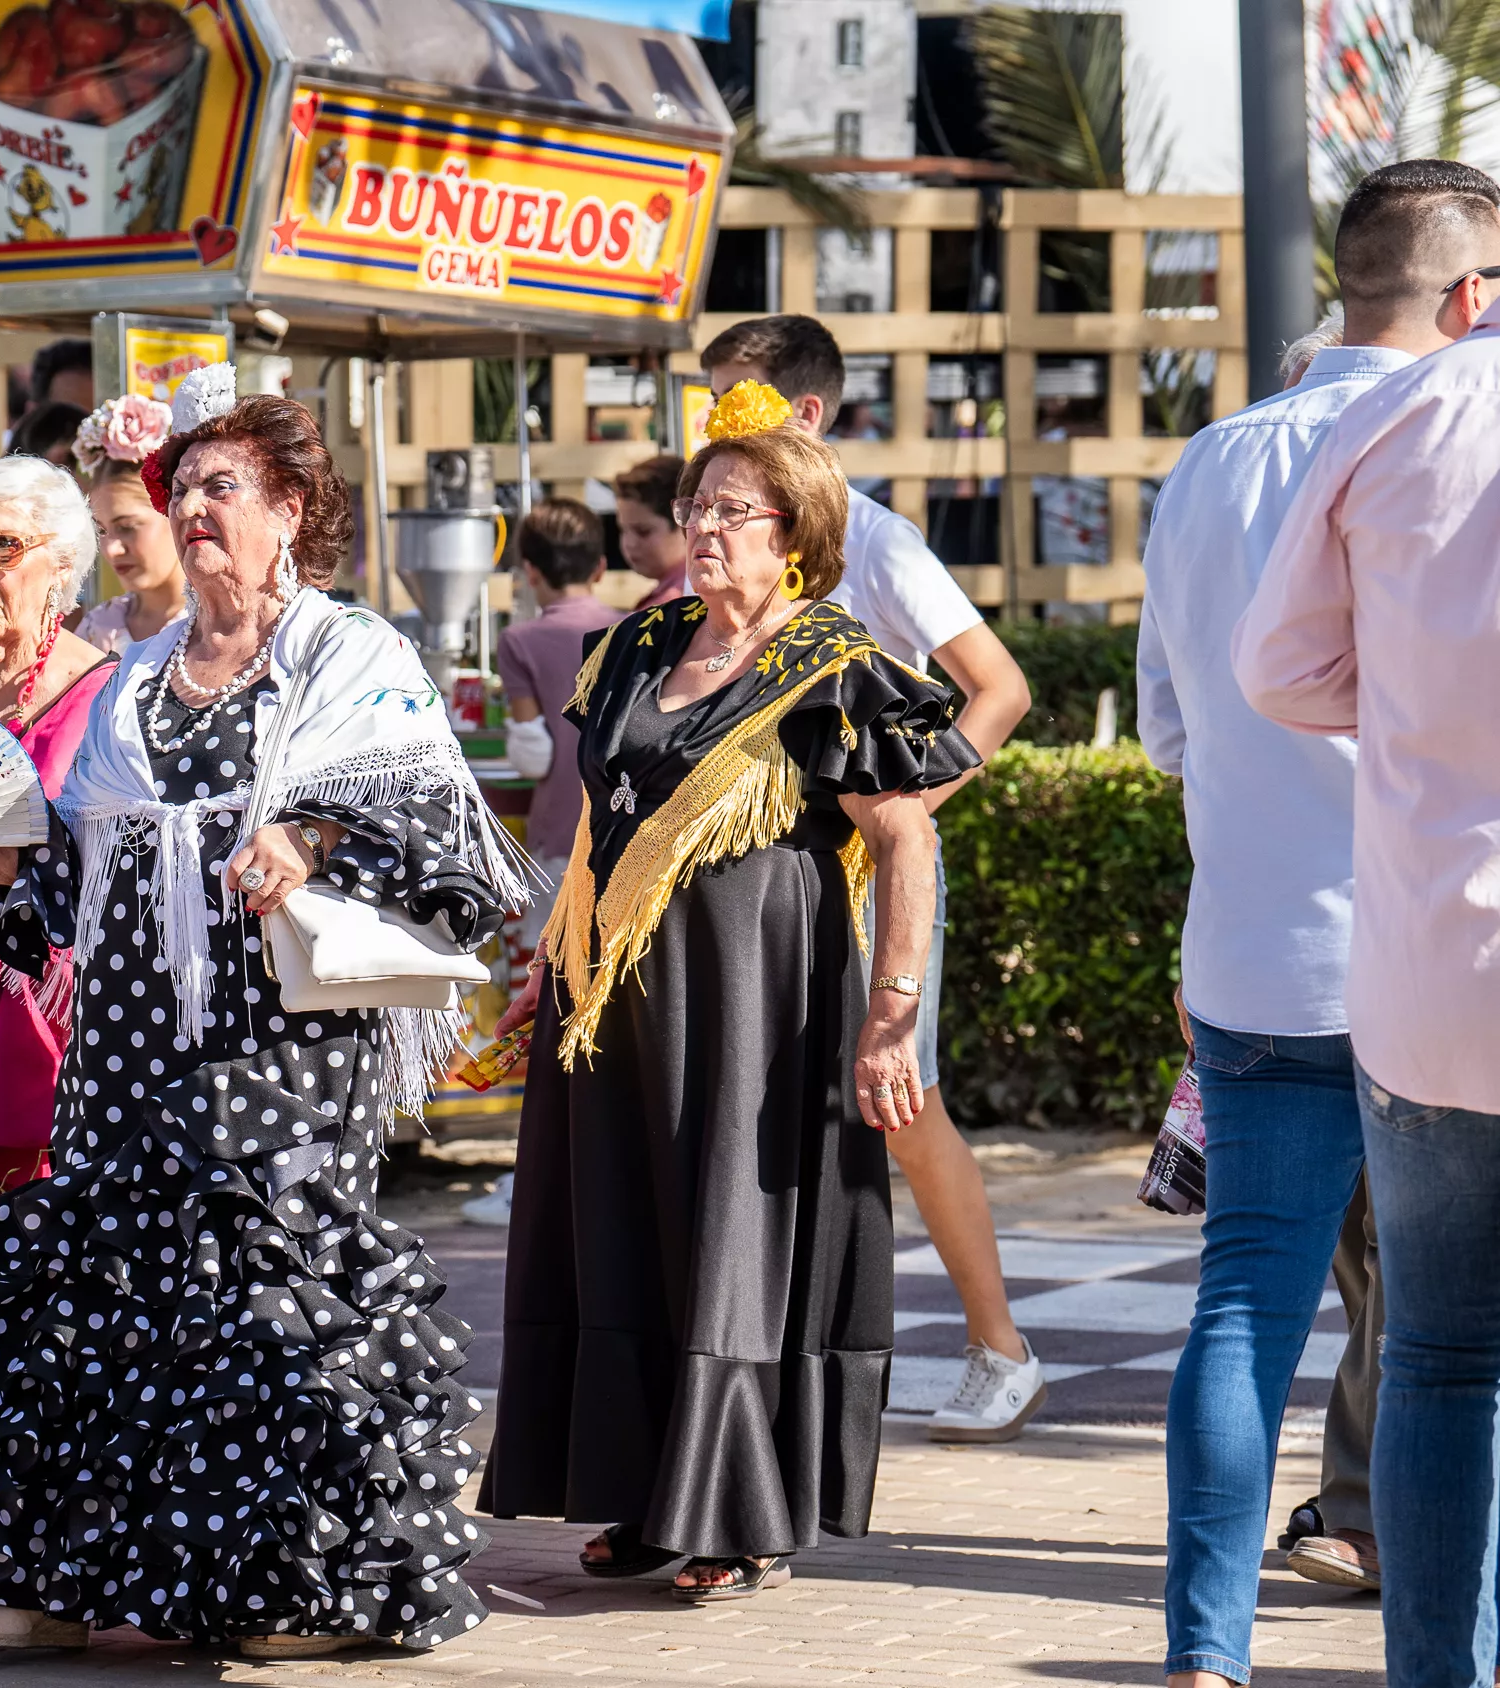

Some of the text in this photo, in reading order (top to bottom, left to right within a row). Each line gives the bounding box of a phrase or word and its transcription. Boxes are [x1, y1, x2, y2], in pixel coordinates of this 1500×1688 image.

[347, 163, 635, 263] BUÑUELOS
[427, 249, 501, 288] GEMA
[1158, 1146, 1185, 1195] Lucena
